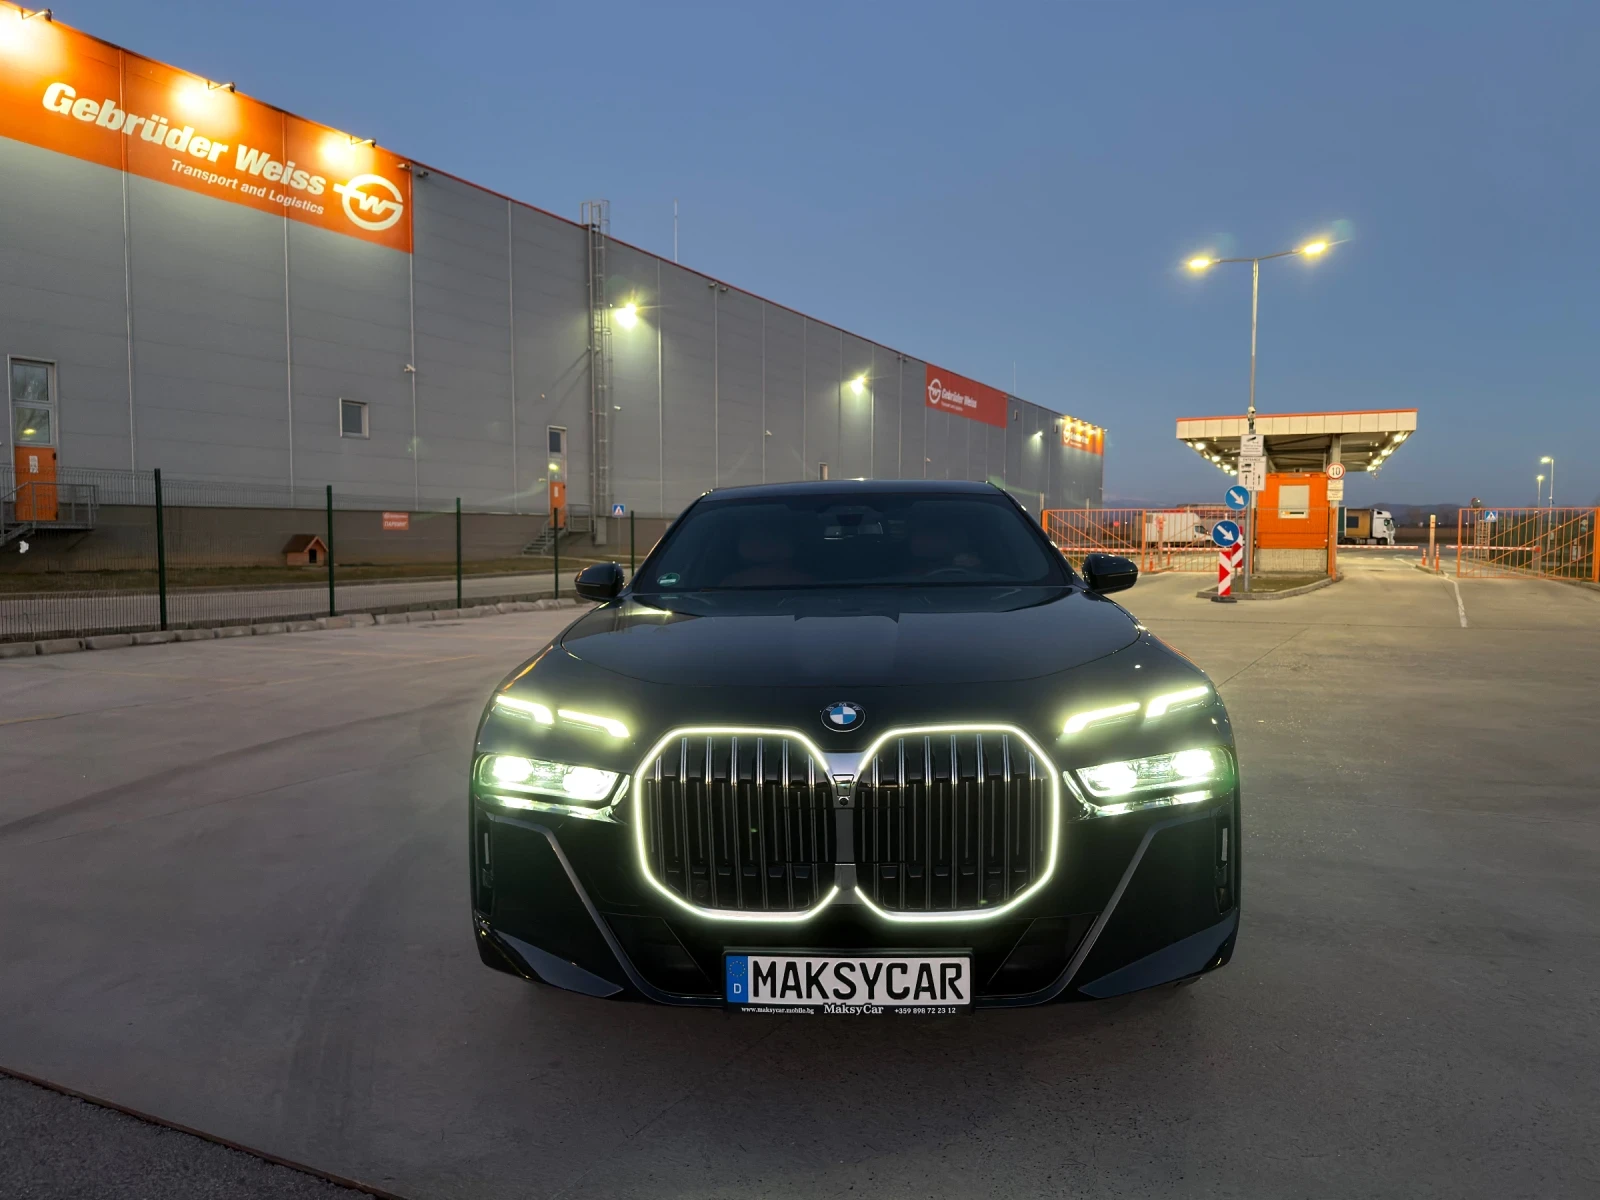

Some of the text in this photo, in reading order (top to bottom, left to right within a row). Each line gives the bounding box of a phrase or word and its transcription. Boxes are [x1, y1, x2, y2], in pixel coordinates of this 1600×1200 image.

[42, 82, 327, 195] Gebrüder Weiss
[171, 159, 325, 215] Transport and Logistics
[1331, 466, 1341, 476] 10
[752, 960, 964, 1001] MAKSYCAR
[733, 983, 742, 994] D
[741, 1006, 815, 1015] www.maksycar.mobile.bg
[823, 1003, 884, 1016] MaksyCar
